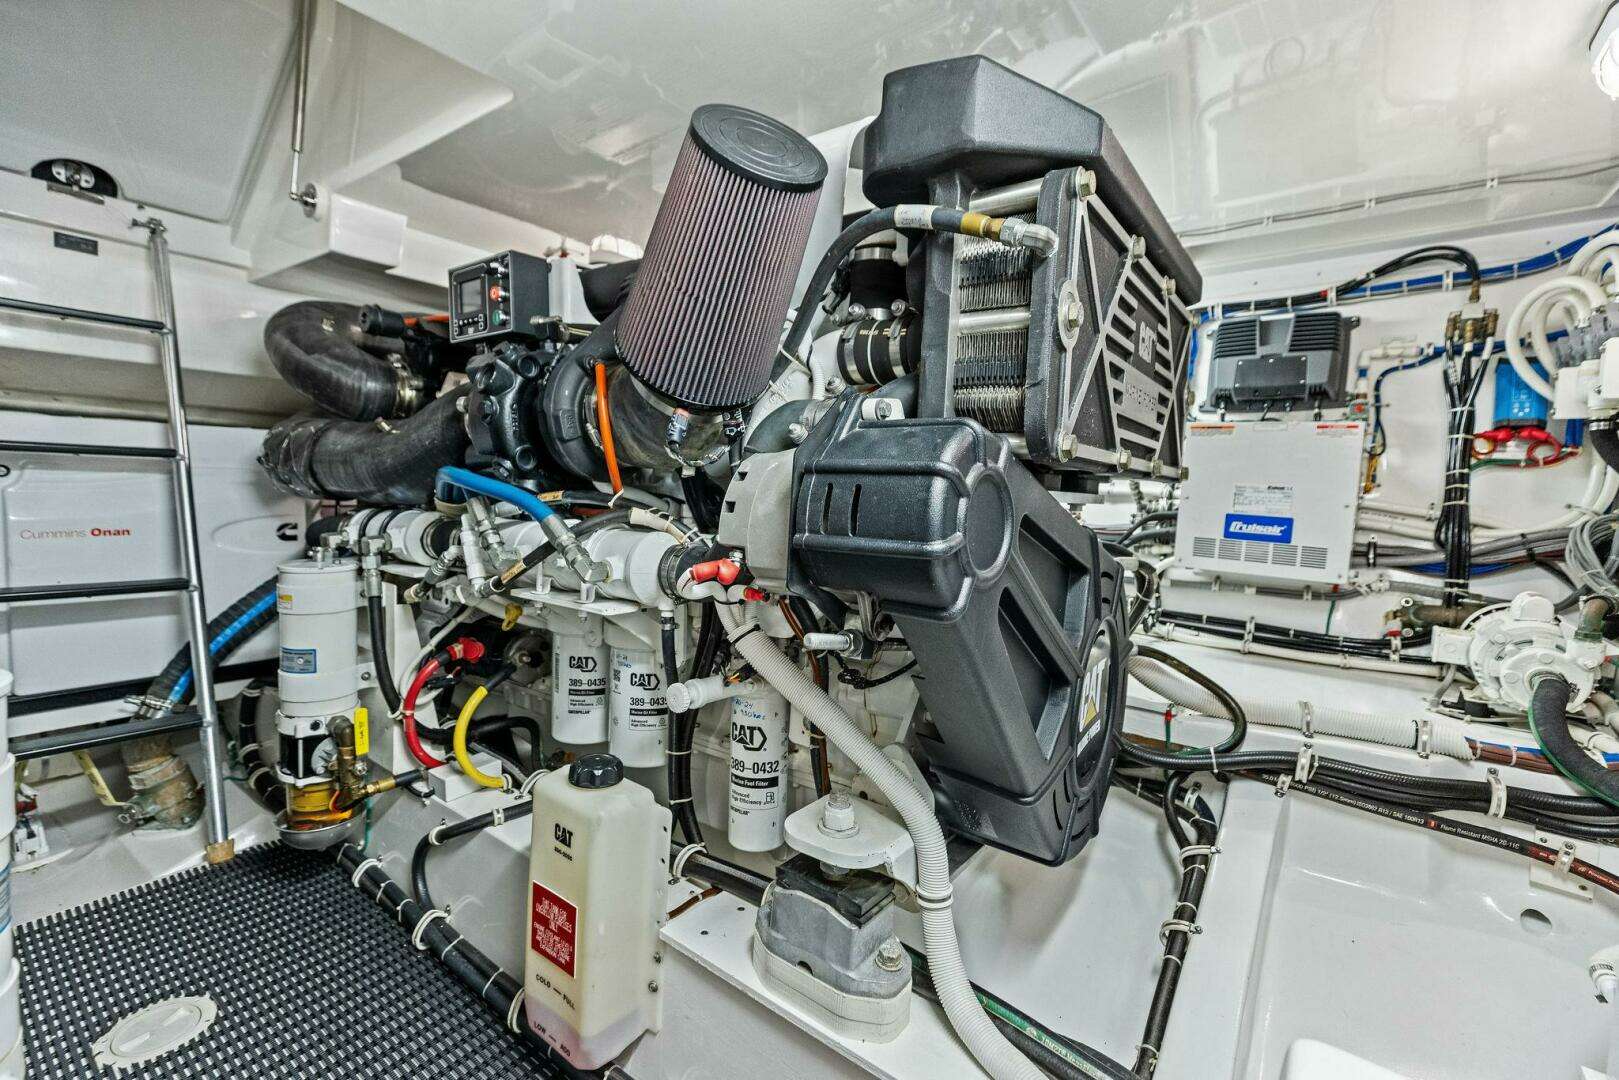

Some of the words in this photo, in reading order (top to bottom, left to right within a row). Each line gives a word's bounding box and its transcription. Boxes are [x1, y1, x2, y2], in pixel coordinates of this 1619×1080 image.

[20, 528, 87, 540] Cummins
[90, 527, 131, 537] Onan
[569, 656, 593, 671] CAT
[568, 678, 606, 687] 389-0435
[631, 673, 656, 689] CAT
[1079, 657, 1107, 732] CAT
[732, 722, 762, 750] CAT
[731, 757, 779, 774] 389-0432
[555, 823, 573, 848] CAT
[536, 974, 551, 988] COLD
[563, 994, 575, 1010] FULL
[534, 1021, 546, 1035] LOW
